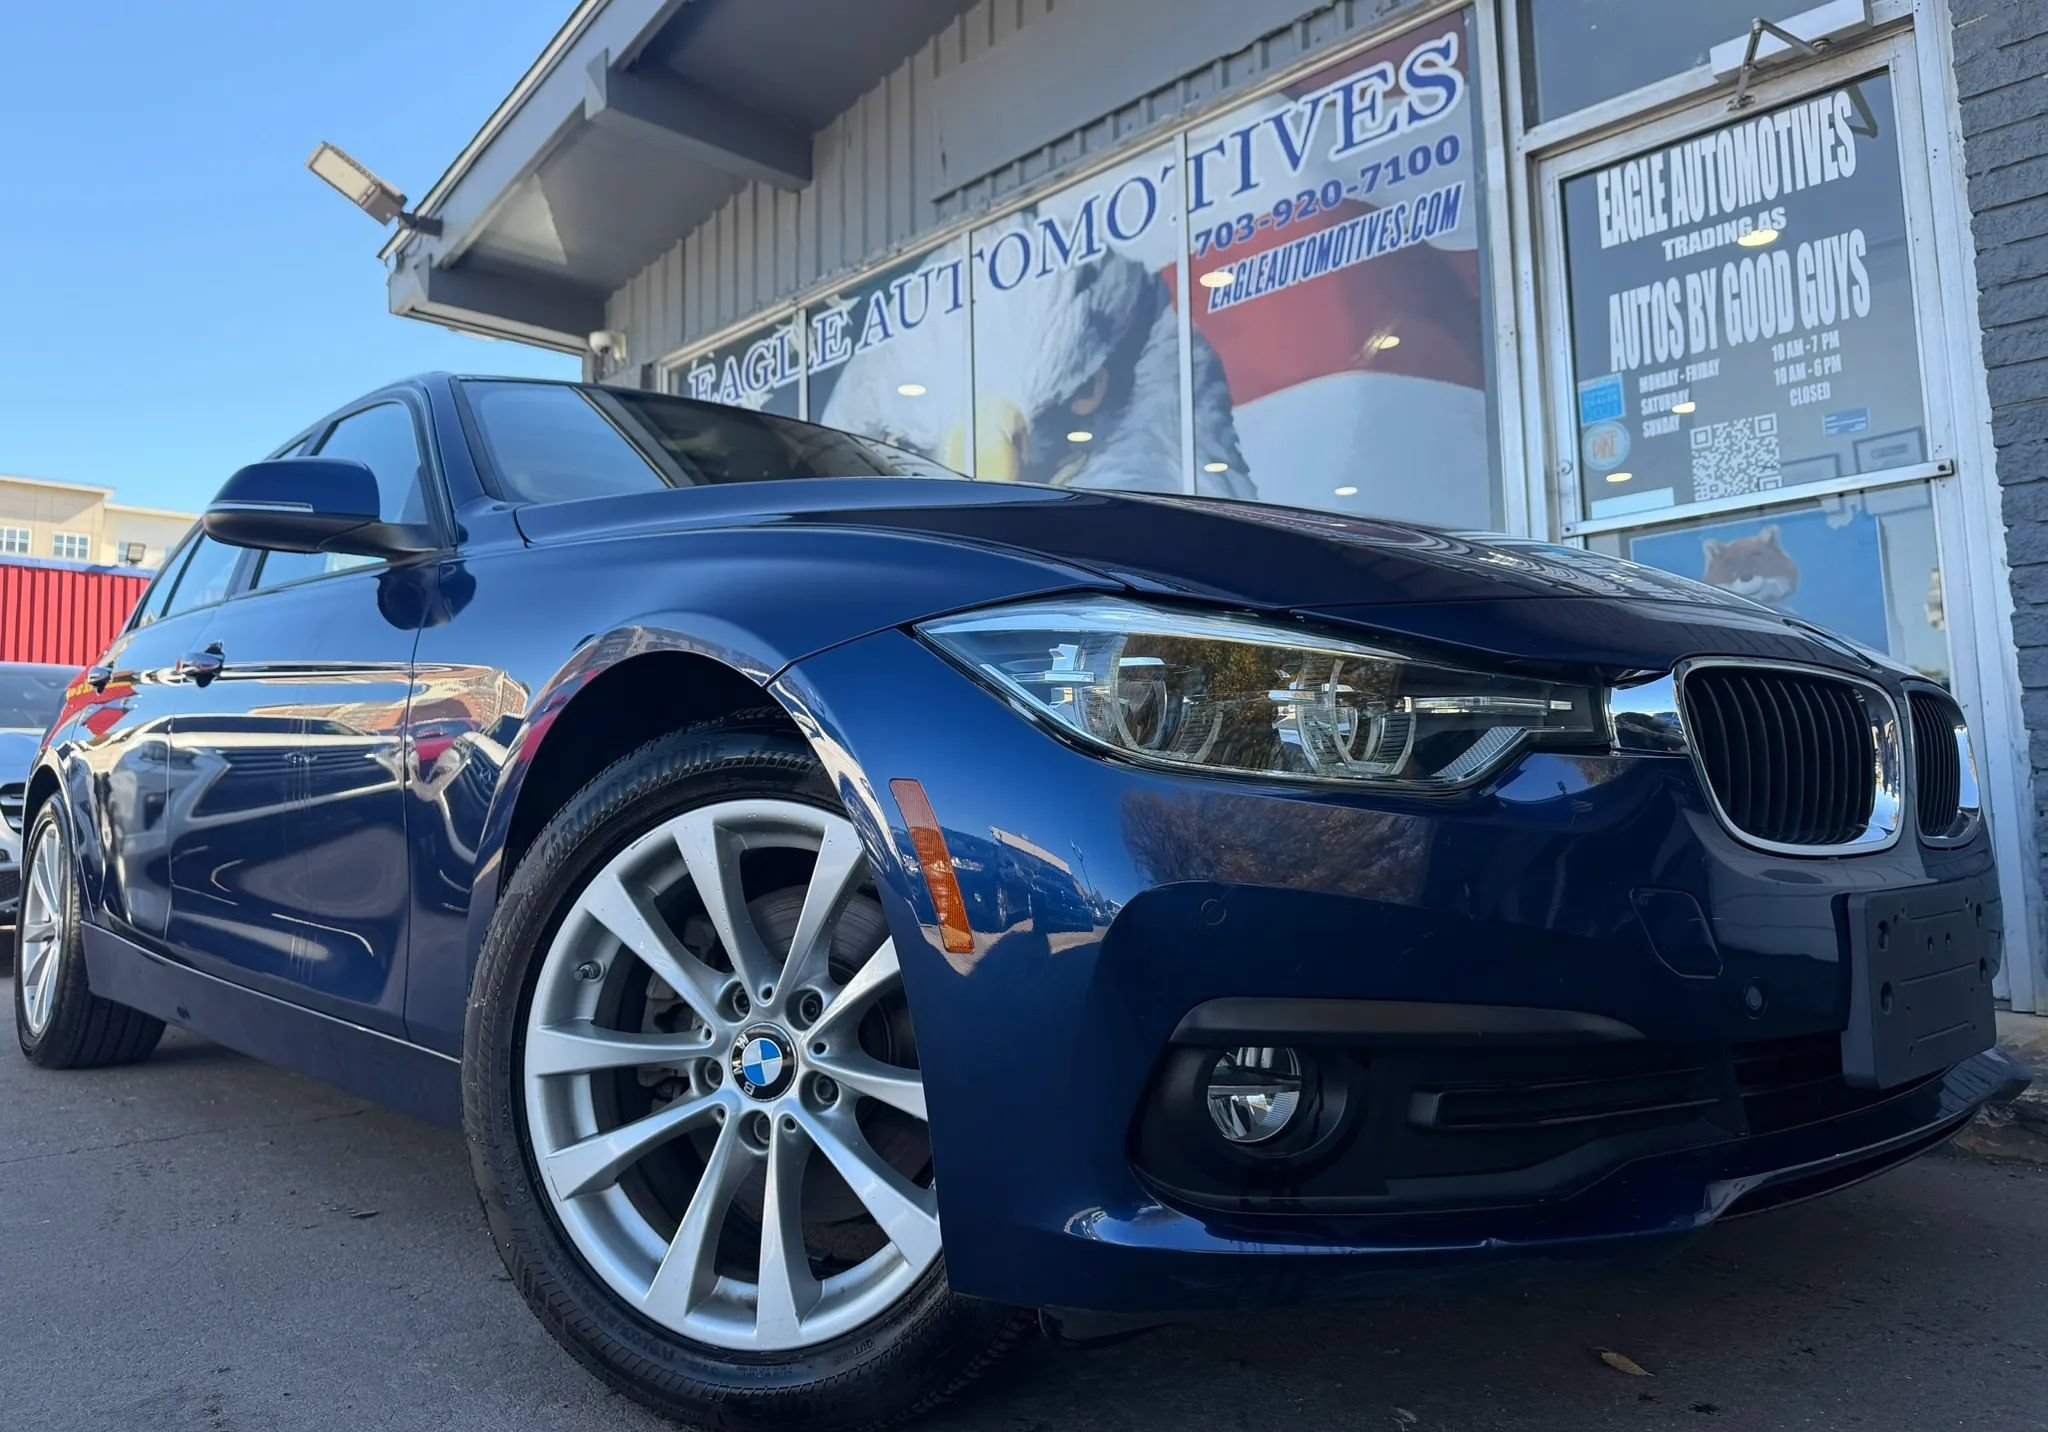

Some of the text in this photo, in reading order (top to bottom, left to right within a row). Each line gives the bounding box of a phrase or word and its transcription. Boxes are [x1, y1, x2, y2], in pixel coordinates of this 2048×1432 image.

[1195, 134, 1461, 259] 703-920-7100
[1597, 91, 1857, 249] EAGLE AUTOMOTIVES
[687, 32, 1465, 403] EAGLE AUTOMOTIVES
[1662, 206, 1788, 262] TRADING AS
[1609, 228, 1871, 373] AUTOS BY GOOD GUYS
[1771, 343, 1785, 363] 10
[1786, 338, 1805, 360] AM
[1822, 330, 1840, 351] PM
[1774, 366, 1788, 387] 10
[1789, 362, 1807, 384] AM
[1824, 354, 1842, 375] PM
[1639, 368, 1679, 394] MONDAY
[1686, 358, 1720, 383] FRIDAY
[1790, 381, 1831, 407] CLOSED
[1642, 414, 1680, 438] SUNDAY
[731, 1033, 756, 1096] BMW
